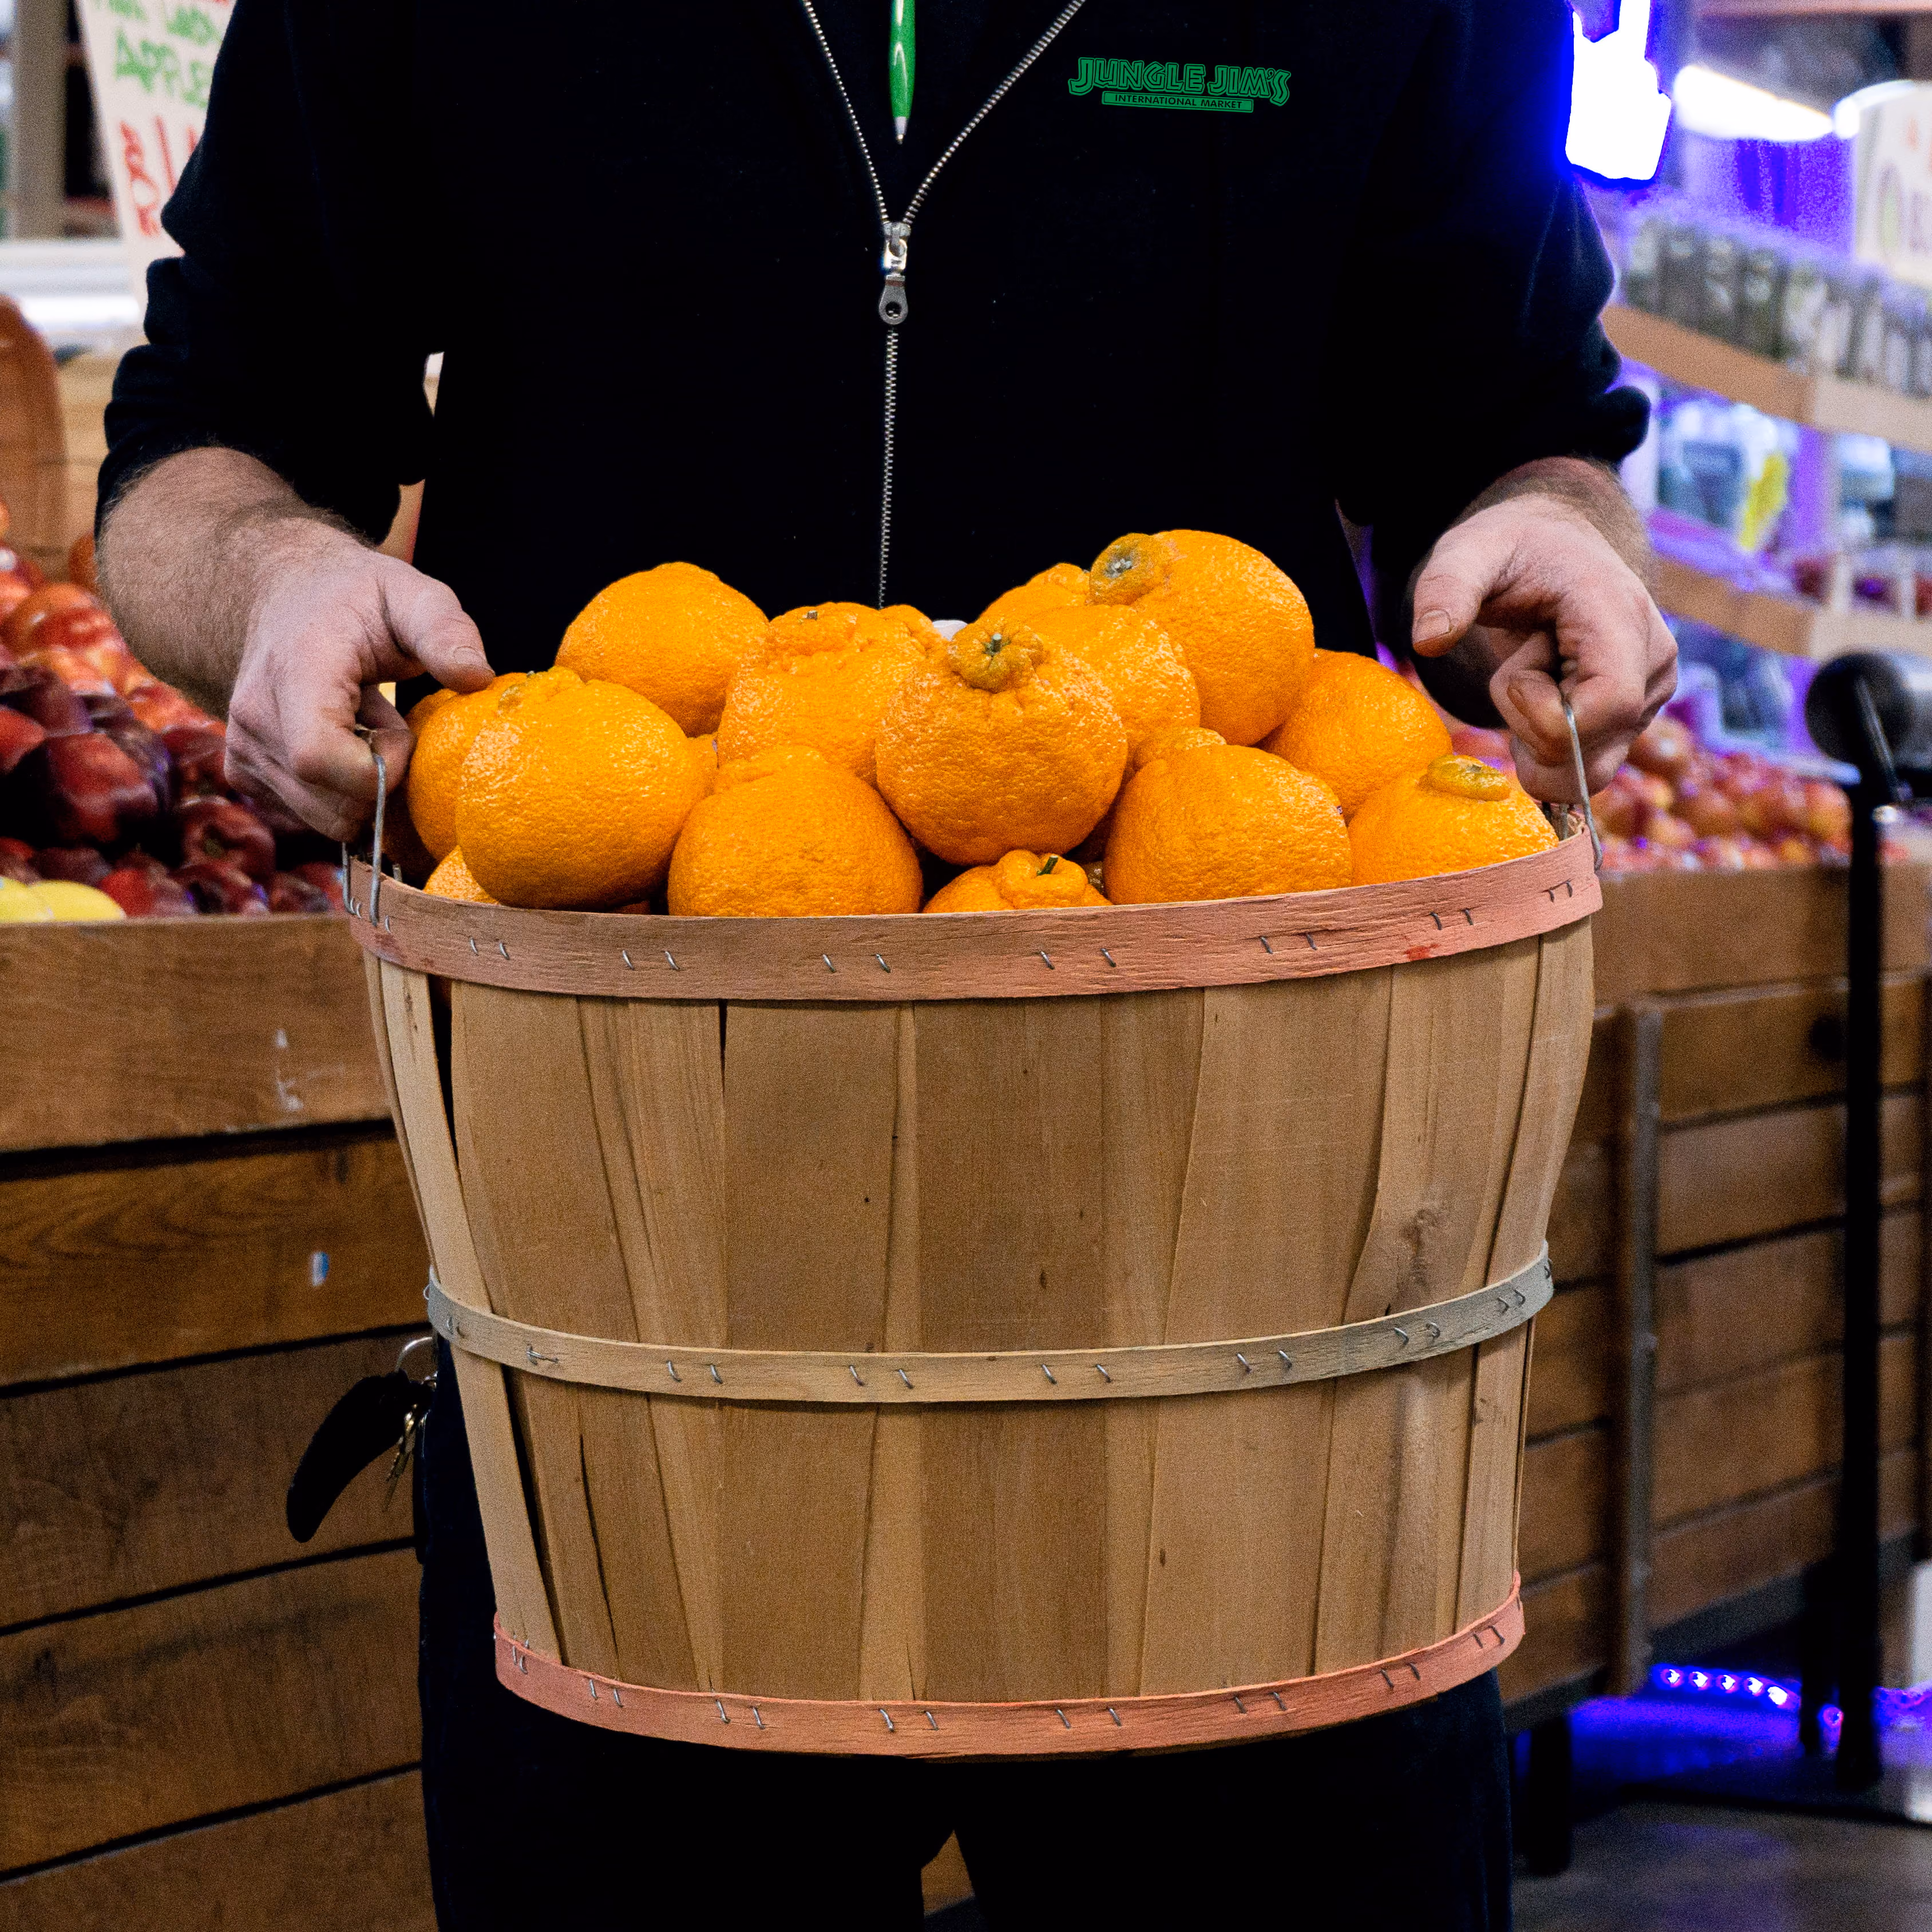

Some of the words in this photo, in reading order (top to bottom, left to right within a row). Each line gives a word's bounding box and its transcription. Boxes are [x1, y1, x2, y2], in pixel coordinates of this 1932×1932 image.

[1068, 57, 1206, 96] JUNGLE
[1207, 65, 1292, 106] JIM'S
[1115, 93, 1197, 106] INTERNATIONAL
[1200, 98, 1243, 109] MARKET
